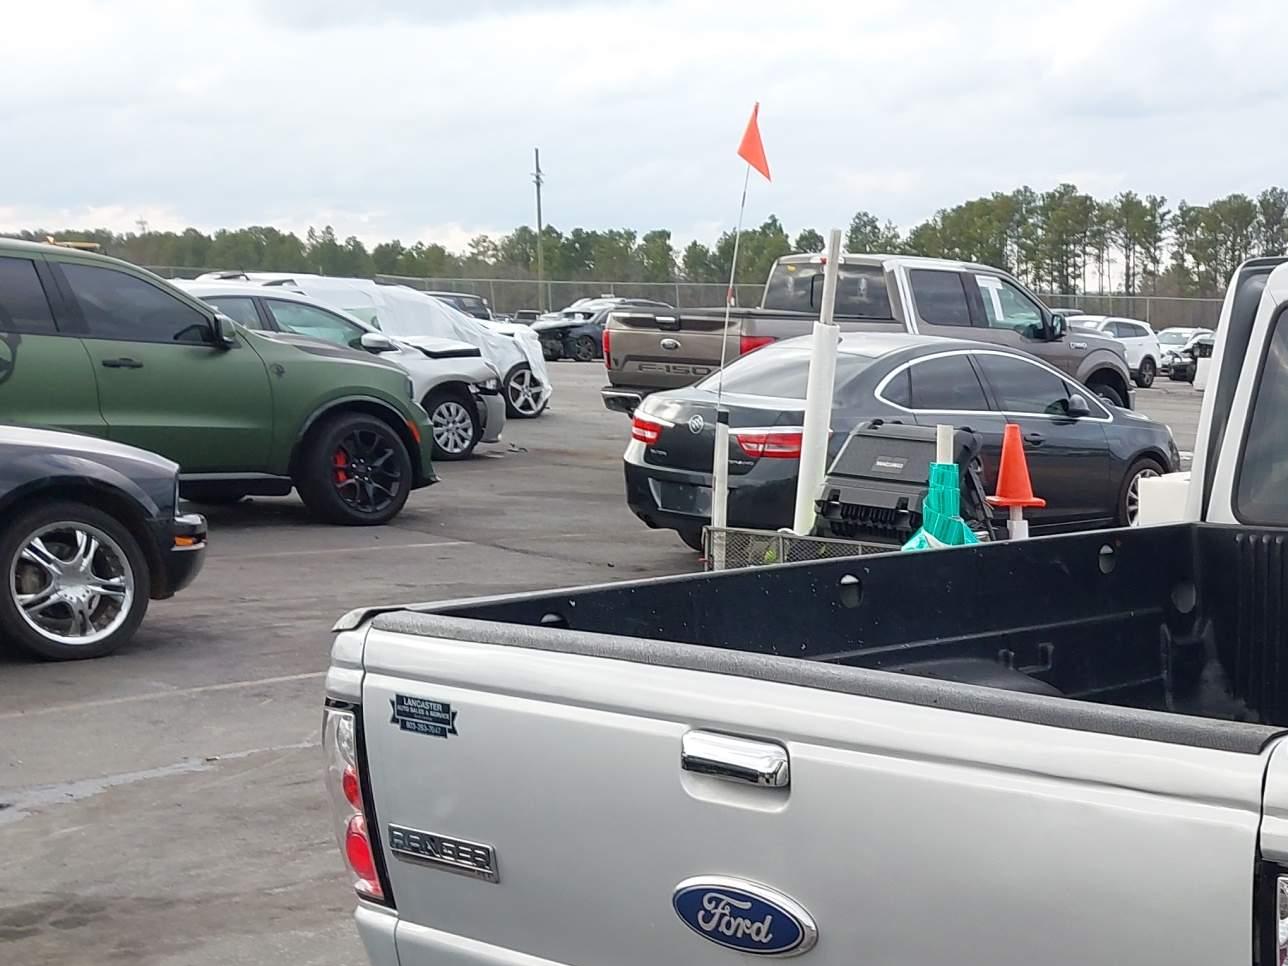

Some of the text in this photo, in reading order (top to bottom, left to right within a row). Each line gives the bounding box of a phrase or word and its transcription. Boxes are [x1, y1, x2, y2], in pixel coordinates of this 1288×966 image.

[638, 362, 712, 377] F-150
[403, 697, 442, 712] LANCASTER
[410, 706, 425, 715] SALES
[391, 829, 491, 870] RANGER
[697, 892, 773, 943] Ford
